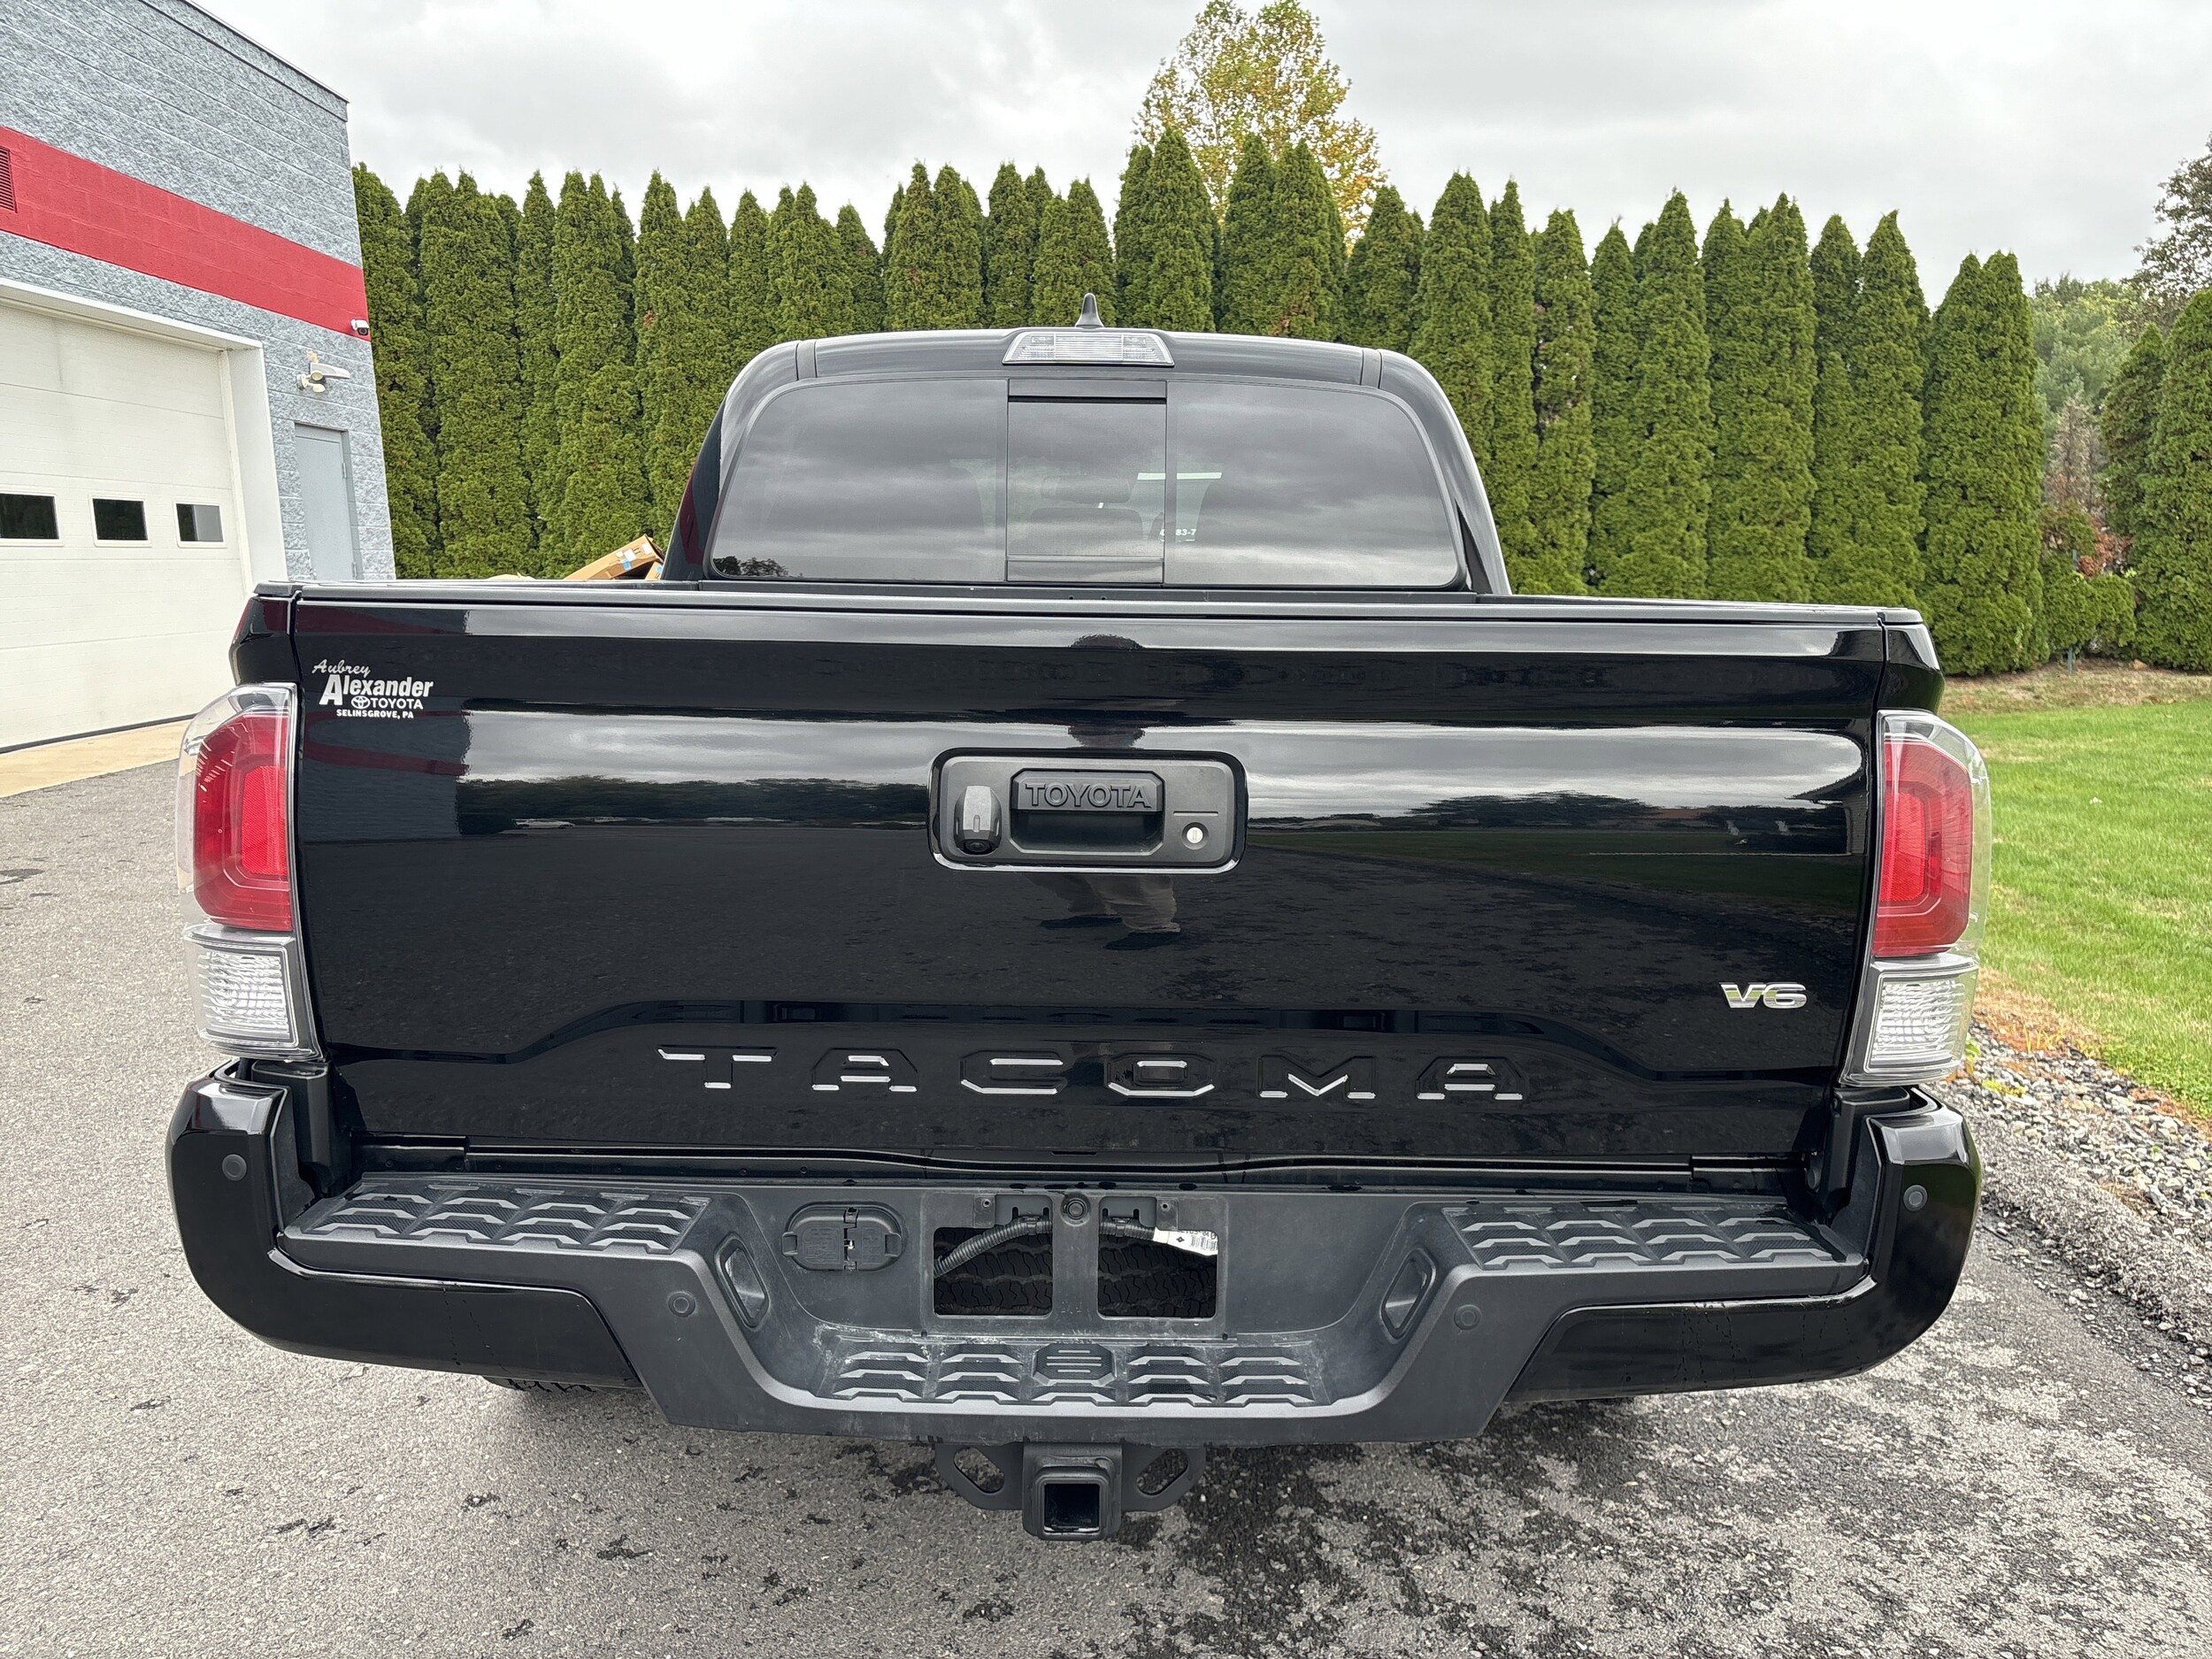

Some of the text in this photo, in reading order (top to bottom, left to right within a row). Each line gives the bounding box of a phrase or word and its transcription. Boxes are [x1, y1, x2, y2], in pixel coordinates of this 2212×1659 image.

[311, 658, 371, 678] Aubrey
[319, 674, 434, 706] Alexander
[370, 697, 424, 710] TOYOTA
[336, 709, 401, 719] SELINSGROVE,
[1025, 782, 1152, 809] TOYOTA
[1719, 981, 1807, 1009] V6
[657, 1044, 1528, 1102] TACOMA
